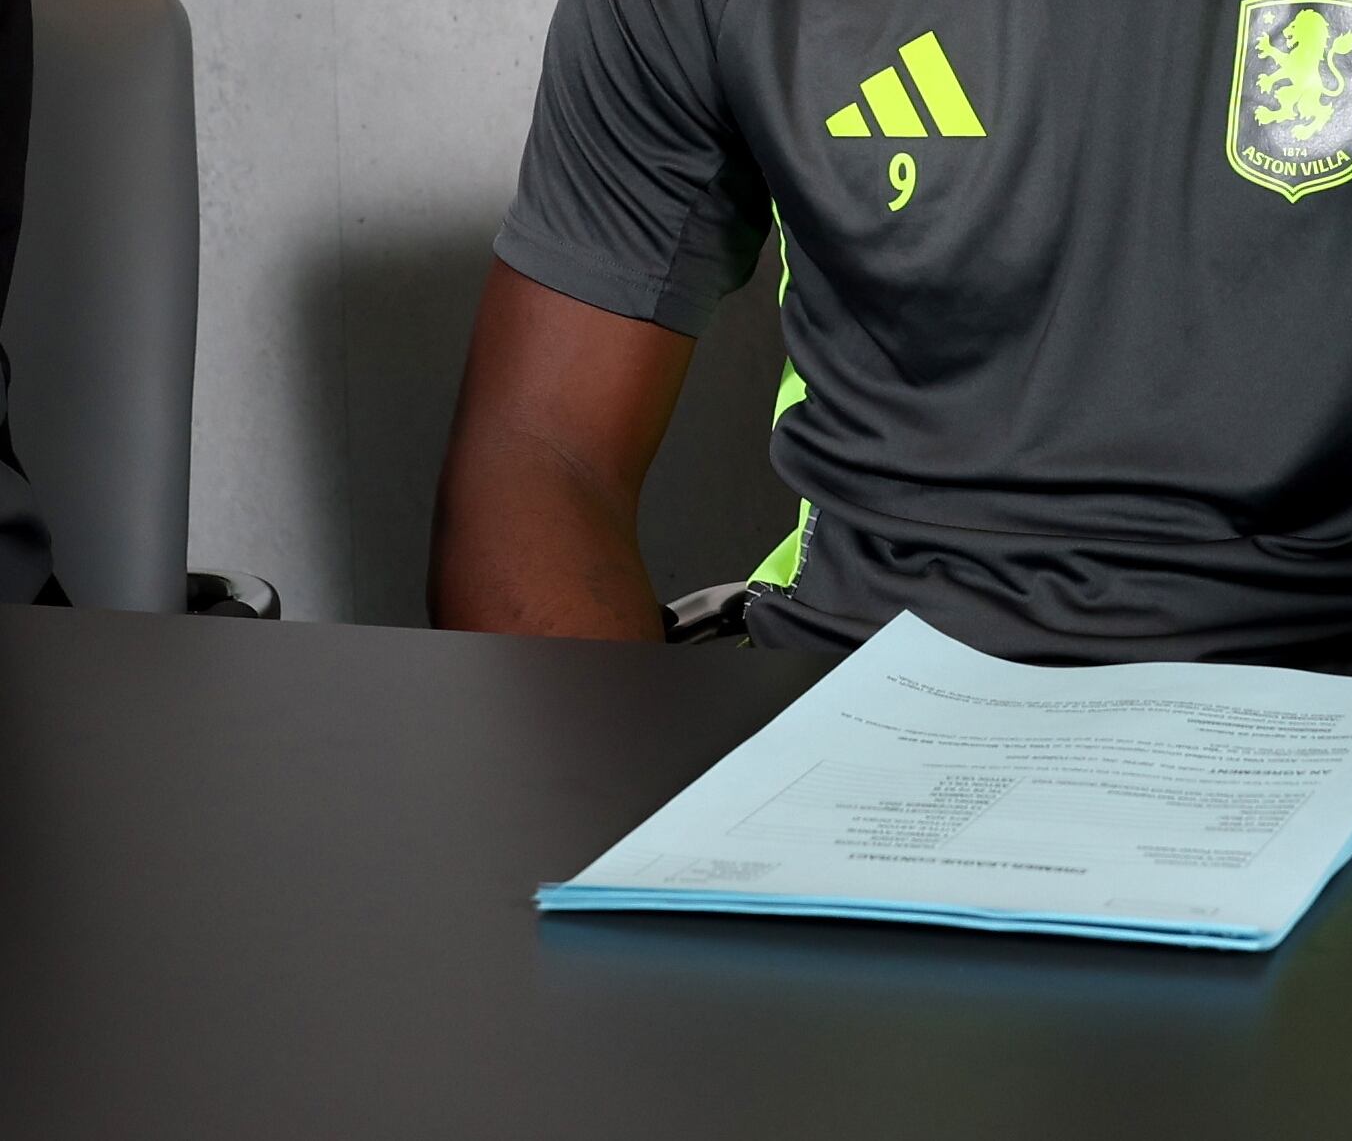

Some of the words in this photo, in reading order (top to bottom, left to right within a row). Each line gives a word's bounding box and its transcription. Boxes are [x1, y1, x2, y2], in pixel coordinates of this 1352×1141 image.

[1242, 145, 1297, 176] ASTON
[1300, 149, 1350, 176] VILLA
[1282, 147, 1308, 157] 1874
[888, 152, 916, 212] 9
